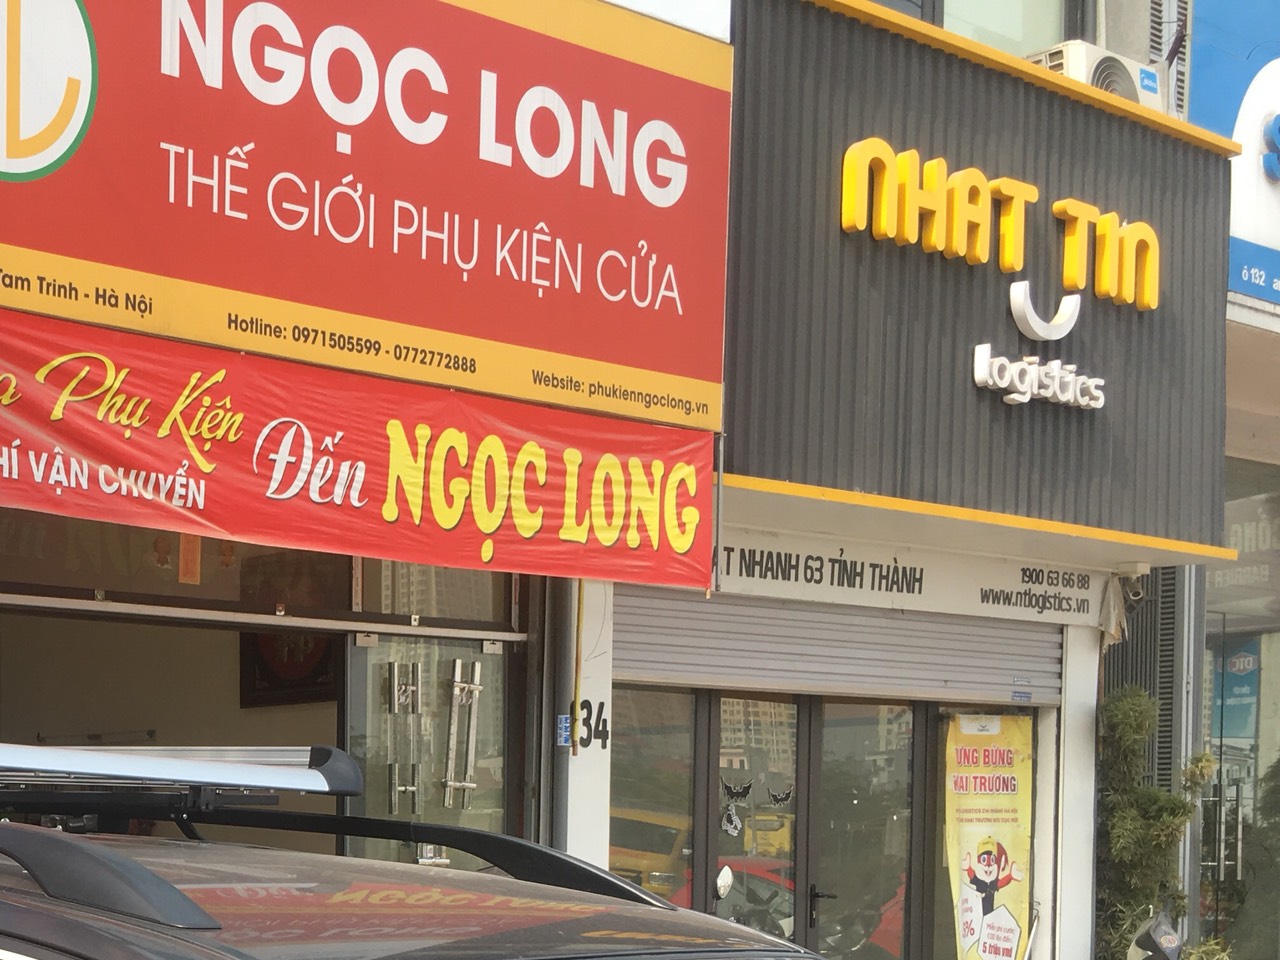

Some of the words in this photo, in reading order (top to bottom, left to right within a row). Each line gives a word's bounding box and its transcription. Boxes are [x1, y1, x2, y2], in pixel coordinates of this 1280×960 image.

[161, 0, 449, 155] NGỌC
[480, 69, 688, 208] LONG
[160, 142, 256, 221] THẾ
[267, 173, 375, 248] GIỚI
[393, 199, 480, 282] PHỤ
[495, 222, 582, 298] KIỆN
[596, 240, 684, 315] CỬA
[842, 137, 1039, 274] NHAT
[1052, 198, 1160, 311] TIN
[37, 275, 79, 301] Trinh
[94, 287, 119, 309] Hà
[124, 293, 154, 318] Nội
[1250, 267, 1266, 287] 132
[227, 313, 288, 341] Hotline:
[291, 325, 382, 358] 0971505599
[393, 343, 477, 374] 0772772888
[531, 369, 586, 394] Website:
[588, 382, 710, 416] phukienngoclong.vn
[974, 343, 1106, 409] logistics
[35, 351, 151, 440] Phụ
[157, 368, 246, 473] Kiện
[28, 445, 90, 495] VẬN
[98, 459, 207, 511] CHUYỂN
[252, 417, 369, 508] Đến
[381, 418, 548, 564] NGỌC
[558, 447, 701, 555] LONG
[739, 547, 800, 582] NHANH
[803, 555, 824, 584] 63
[828, 548, 865, 590] TỈNH
[869, 557, 925, 595] THÀNH
[980, 587, 1090, 615] www.ntlogistics.vn
[1020, 567, 1045, 586] 1900
[1046, 569, 1060, 587] 63
[1061, 571, 1075, 589] 66
[1076, 573, 1090, 590] 88
